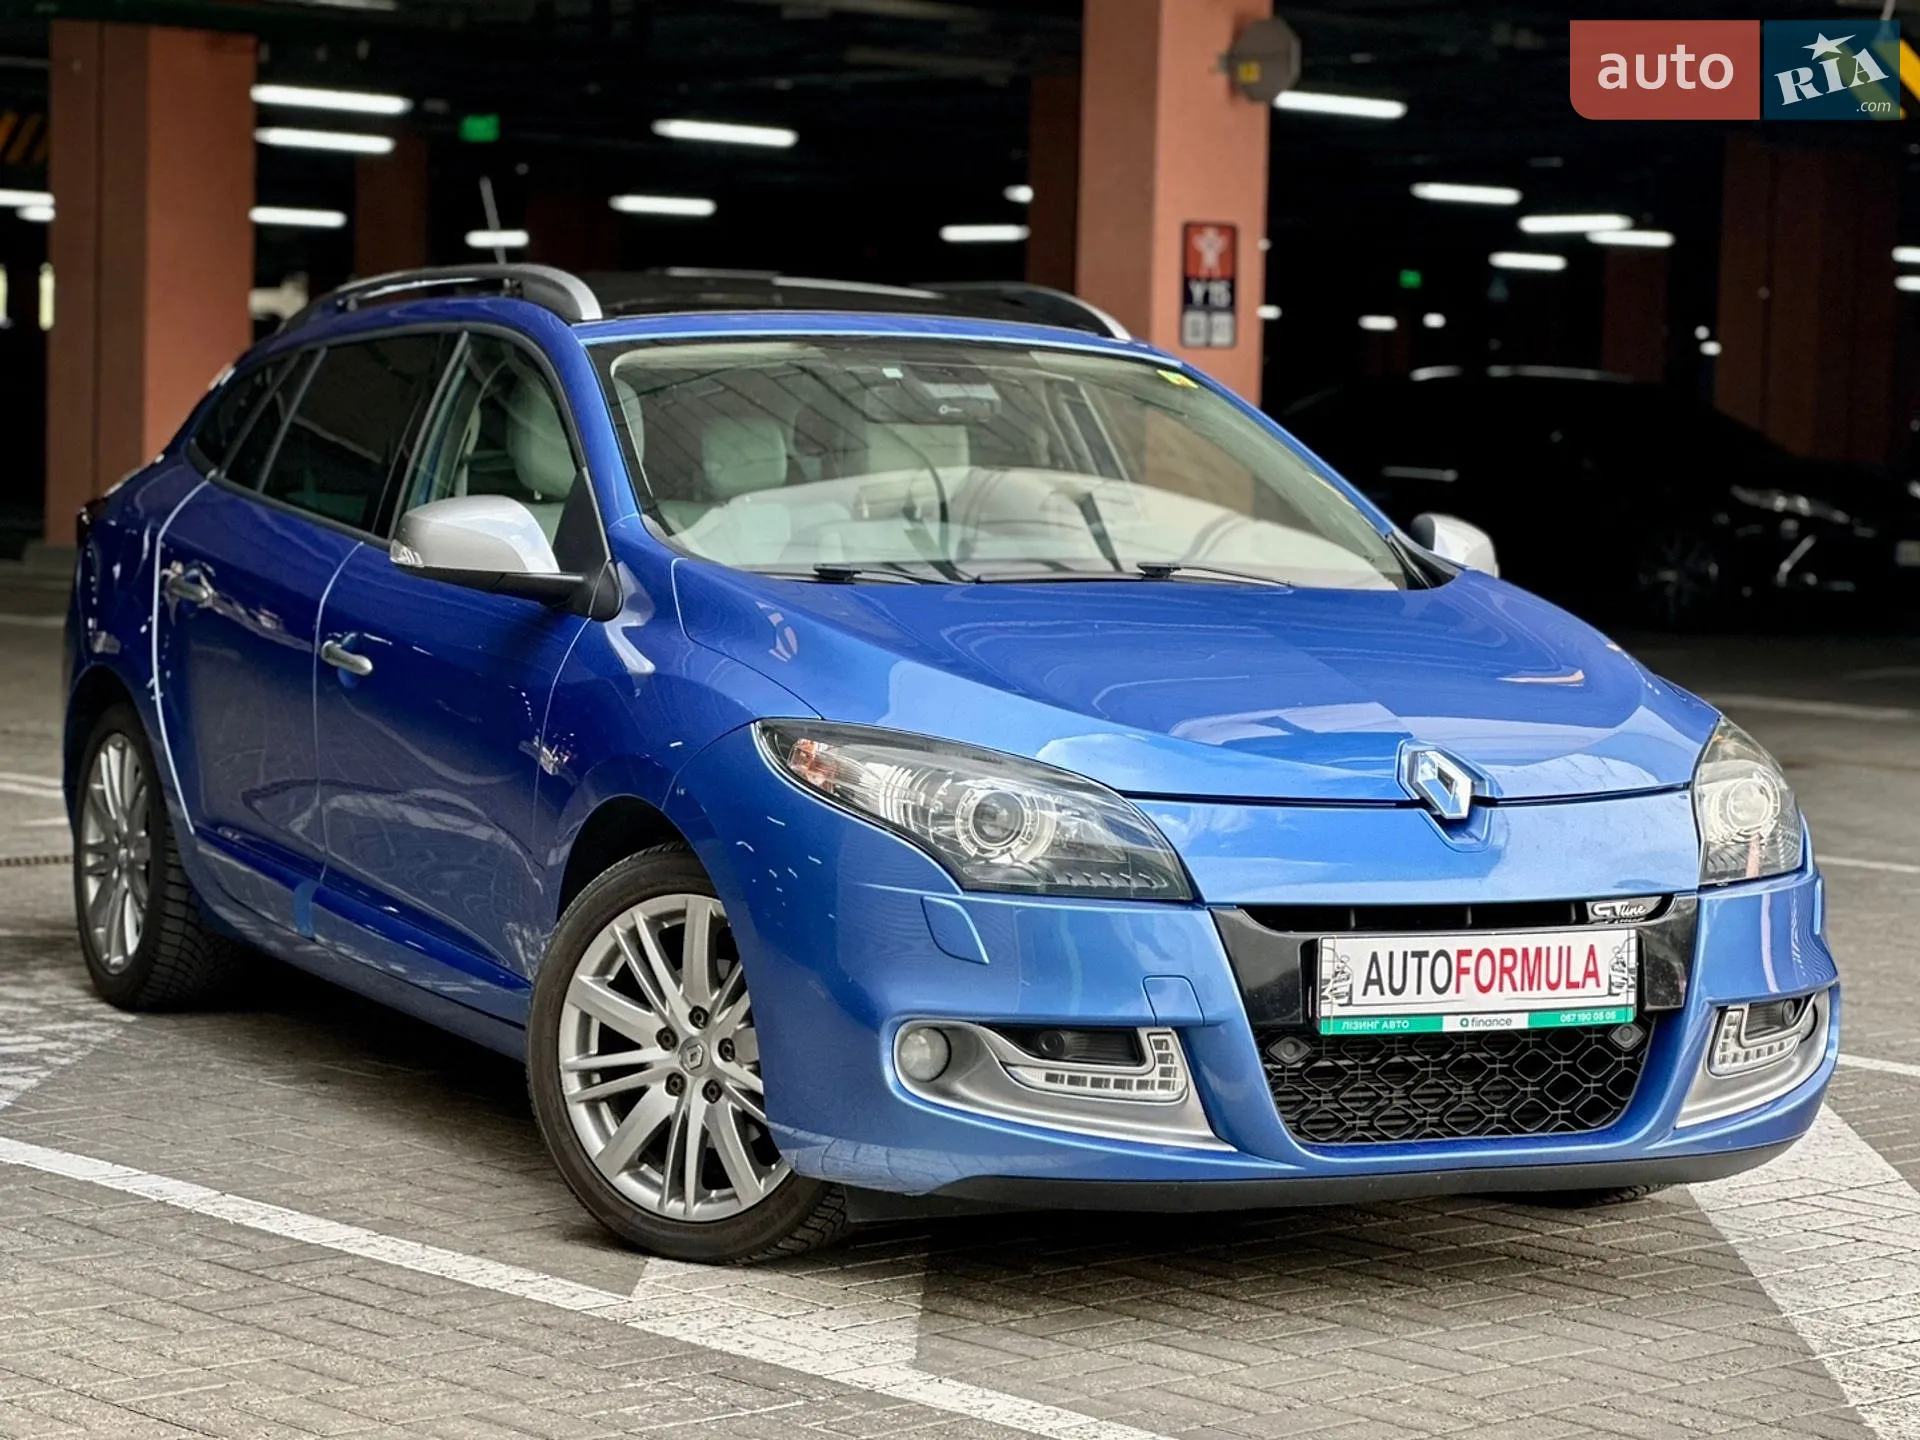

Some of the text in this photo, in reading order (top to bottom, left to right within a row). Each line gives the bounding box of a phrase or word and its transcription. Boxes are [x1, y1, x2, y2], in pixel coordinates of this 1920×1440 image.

[1361, 944, 1601, 997] AUTOFORMULA
[1381, 1019, 1409, 1029] АВТО
[1471, 1016, 1512, 1027] finance
